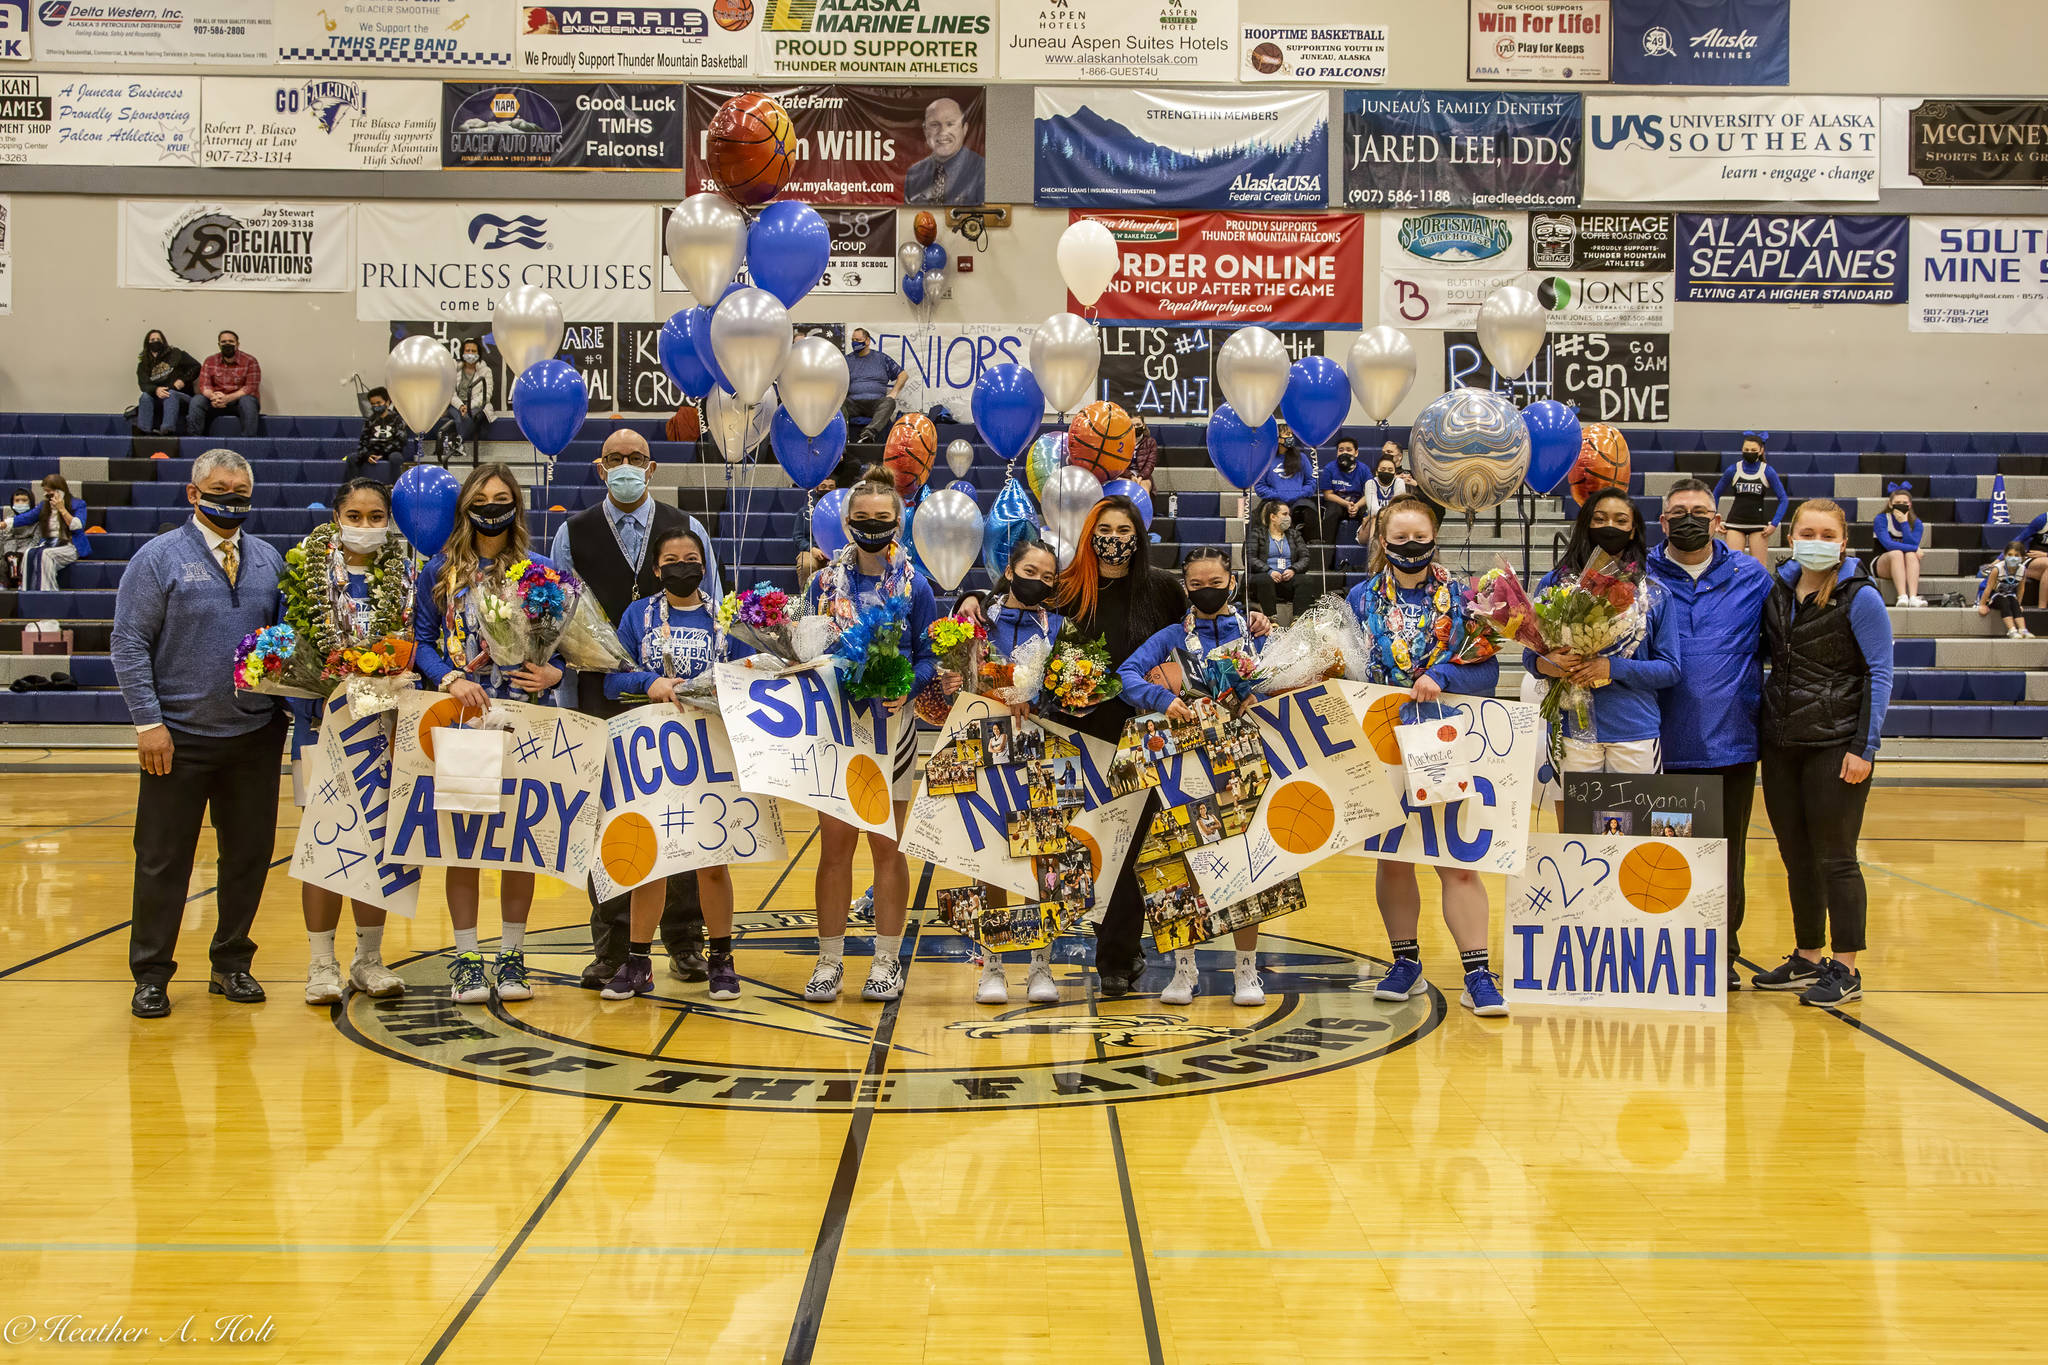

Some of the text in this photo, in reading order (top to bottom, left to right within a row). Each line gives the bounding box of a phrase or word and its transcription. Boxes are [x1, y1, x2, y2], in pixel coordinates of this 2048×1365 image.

[70, 6, 184, 19] Delta Western, Inc.
[1040, 12, 1086, 20] ASPEN
[816, 15, 990, 34] MARINE LINES
[1478, 12, 1600, 34] Win For Life!
[328, 36, 458, 51] TMHS PEP BAND
[1010, 34, 1228, 52] Juneau Aspen Suites Hotels
[1245, 29, 1384, 40] HOOPTIME BASKETBALL
[1652, 37, 1664, 46] 49
[776, 40, 978, 57] PROUD SUPPORTER
[525, 51, 748, 69] We Proudly Support Thunder Mountain Basketball
[774, 61, 978, 72] THUNDER MOUNTAIN ATHLETICS
[1045, 54, 1198, 64] www.alaskanhotelsak.com
[496, 100, 516, 112] NAPA
[576, 95, 676, 112] Good Luck
[60, 106, 190, 124] Proudly Sponsoring
[1147, 110, 1278, 121] STRENGTH IN MEMBERS
[1670, 114, 1875, 128] UNIVERSITY OF ALASKA
[204, 123, 296, 136] Robert P. Blasco
[598, 118, 653, 134] TMHS
[1591, 114, 1664, 150] UAS
[59, 128, 165, 143] Falcon Athletics
[354, 132, 433, 143] proudly supports
[451, 134, 563, 154] GLACIER AUTO PARTS
[1670, 132, 1876, 152] SOUTHEAST
[167, 144, 190, 152] KYLIE!
[349, 143, 438, 153] Thunder Mountain
[586, 141, 664, 156] Falcons!
[817, 130, 896, 161] Willis
[1351, 134, 1572, 170] JARED LEE, DDS
[205, 150, 292, 164] 907-723-1314
[1230, 174, 1320, 192] AlaskaUSA
[1721, 165, 1875, 184] learn engage change
[1348, 190, 1450, 203] (907) 586-1188
[1472, 192, 1575, 206] jaredleedds.com
[262, 208, 314, 218] Jay Stewart
[1226, 220, 1318, 232] PROUDLY SUPPORTS
[1582, 216, 1668, 232] HERITAGE
[1689, 218, 1840, 248] ALASKA
[1202, 230, 1340, 244] THUNDER MOUNTAIN FALCONS
[1401, 217, 1509, 250] SPORTSMAN'S
[1581, 232, 1668, 240] COFFEE ROASTING CO.
[1941, 229, 2048, 254] SOUT
[830, 240, 866, 254] Group
[1619, 252, 1666, 260] MOUNTAIN
[1117, 252, 1336, 280] RDER ONLINE
[1690, 248, 1896, 280] SEAPLANES
[1924, 258, 2020, 282] MINE
[362, 263, 652, 290] PRINCESS CRUISES
[1136, 281, 1173, 294] PICK
[1176, 282, 1198, 294] UP
[1202, 282, 1252, 296] AFTER
[1254, 284, 1285, 296] THE
[1289, 284, 1334, 297] GAME
[1577, 278, 1664, 310] JONES
[1690, 288, 1894, 300] FLYING AT A HIGHER STANDARD
[440, 300, 479, 311] come
[1923, 308, 1989, 316] 907-789-7121
[1174, 328, 1209, 354] #1
[1282, 332, 1315, 360] Hit
[1555, 333, 1610, 361] #5
[871, 334, 1022, 389] ENIORS
[1144, 354, 1178, 380] GO
[1634, 356, 1668, 372] SAM
[1600, 384, 1670, 422] DIVE
[746, 666, 888, 755] SAM
[512, 718, 583, 774] #4
[791, 744, 846, 800] #12
[1568, 780, 1706, 822] #23 Iayanah
[391, 775, 590, 873] AVERY
[660, 792, 760, 858] #33
[1525, 840, 1610, 916] #23
[1512, 925, 1716, 997] IAYANAH
[954, 1016, 1392, 1101] FALCONS
[462, 1046, 896, 1103] OF THE
